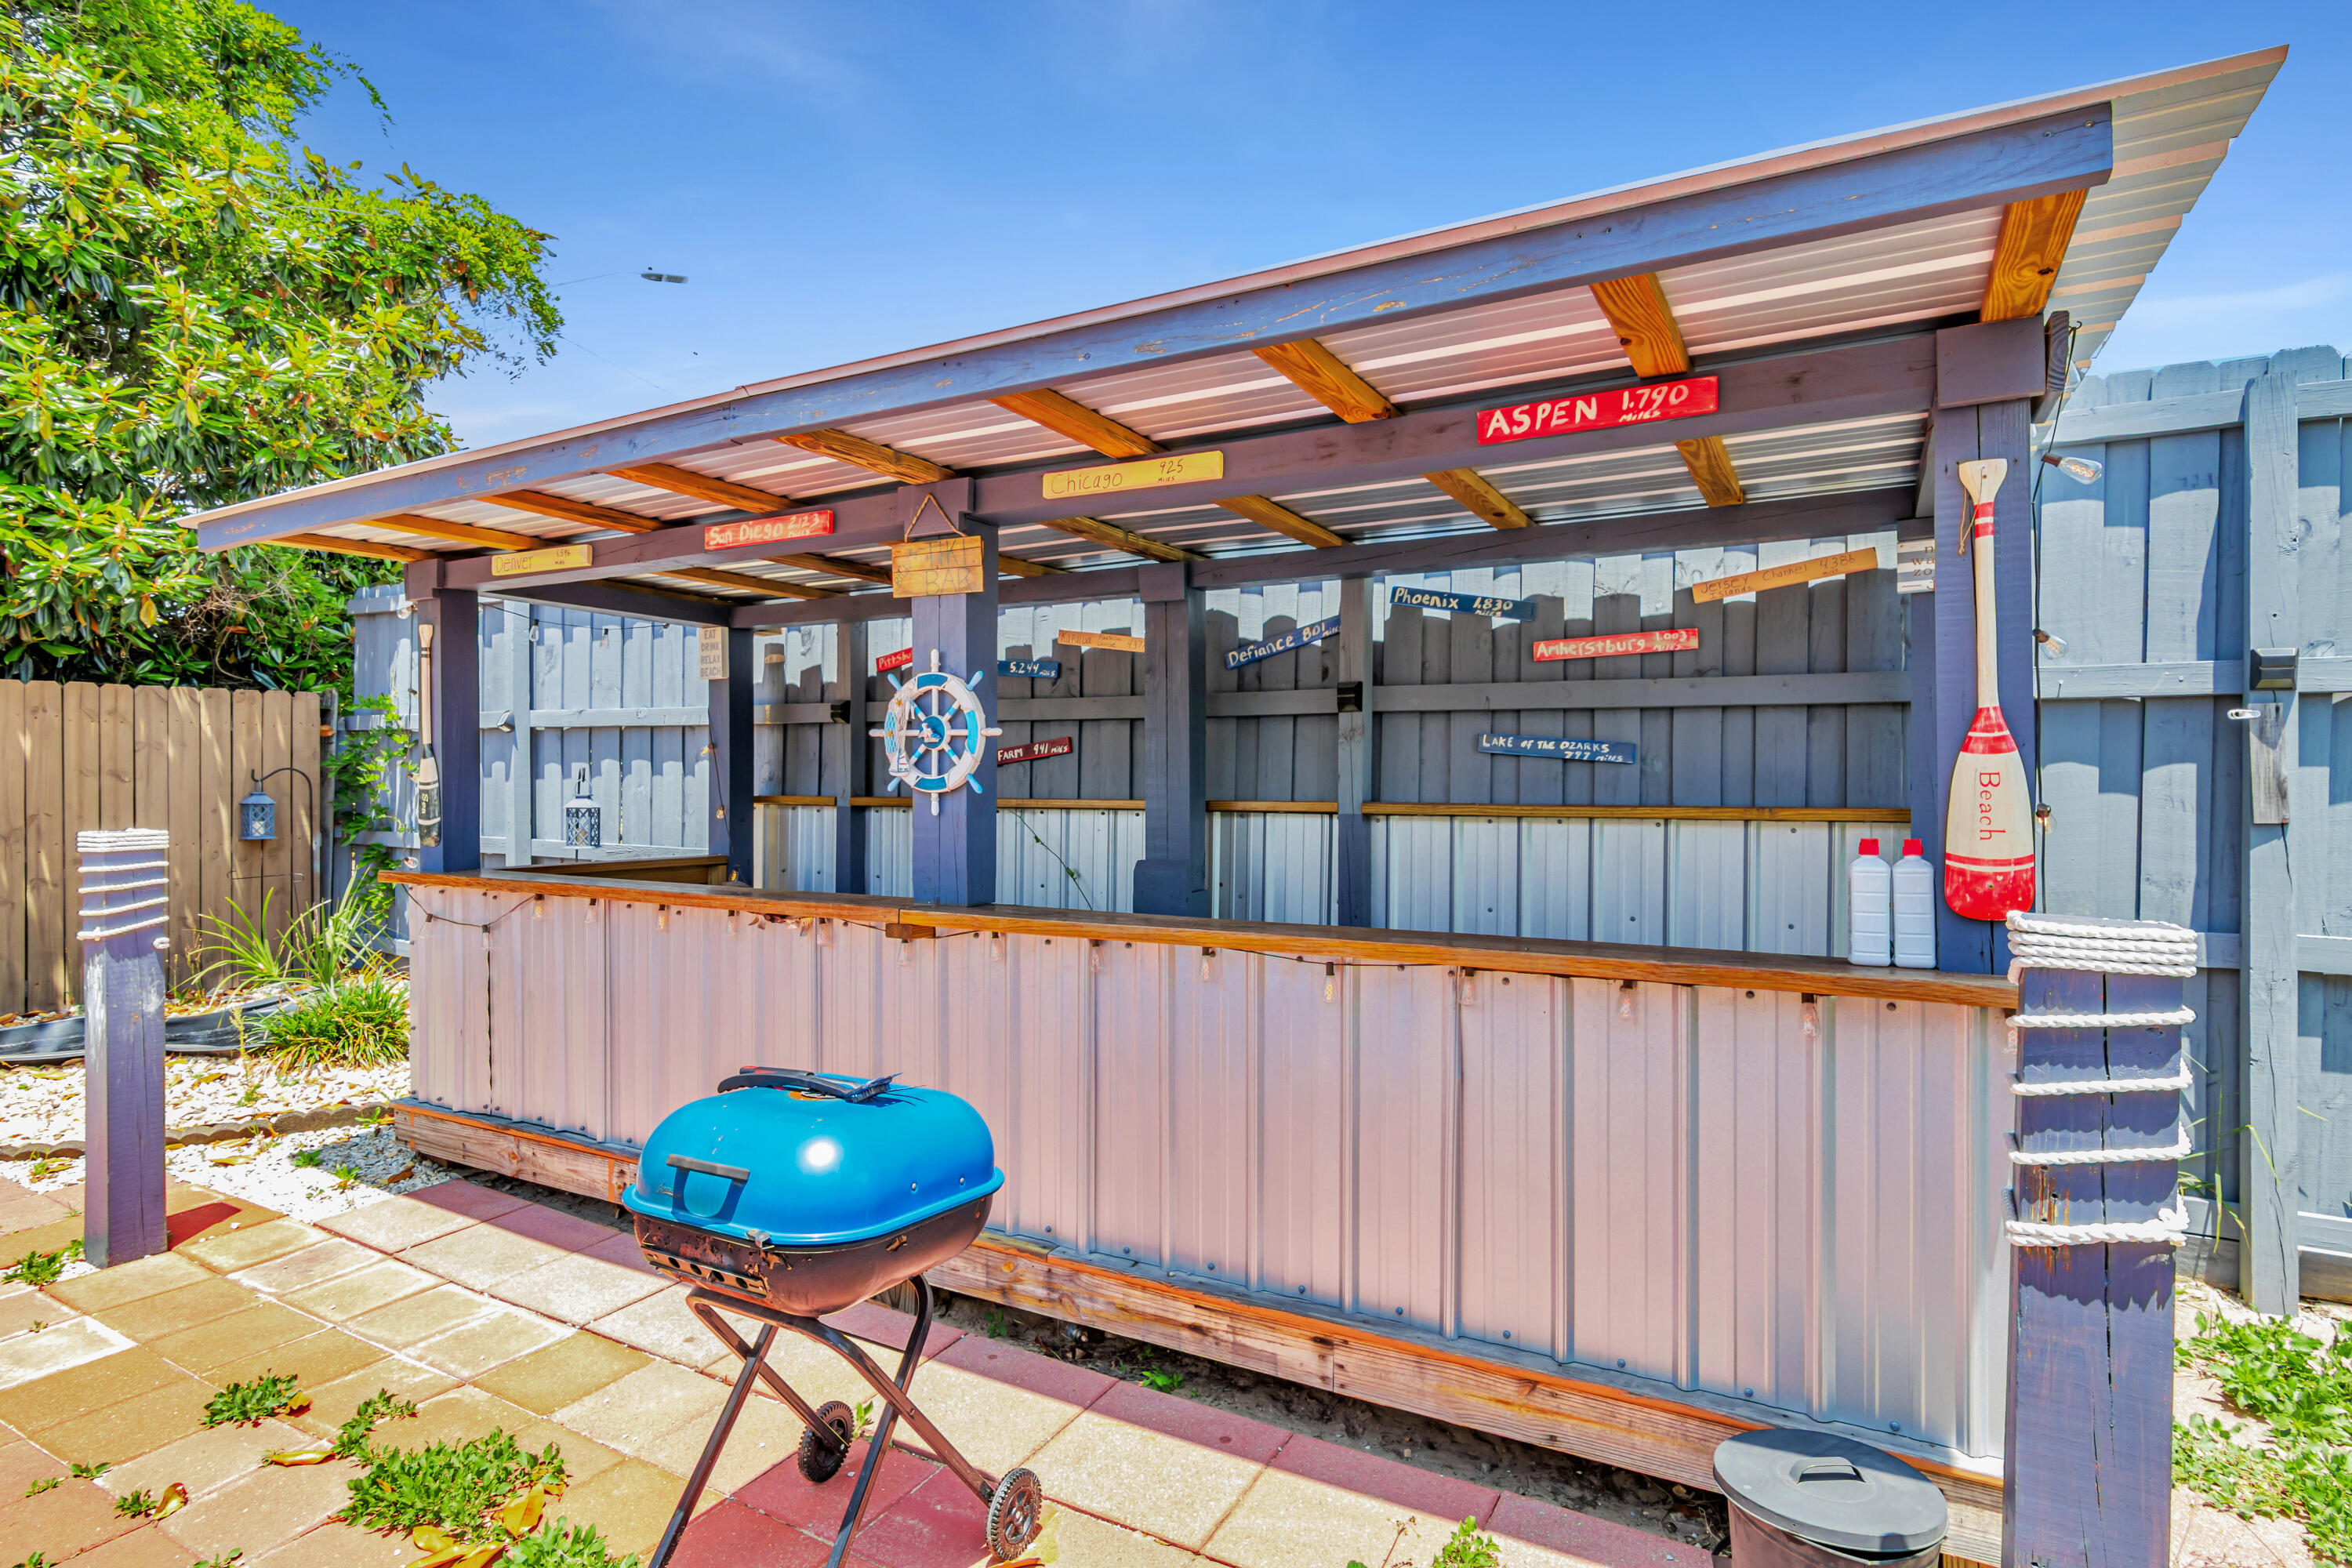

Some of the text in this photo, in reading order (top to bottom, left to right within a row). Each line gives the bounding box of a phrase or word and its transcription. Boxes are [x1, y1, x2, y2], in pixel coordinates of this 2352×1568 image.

[1486, 385, 1689, 438] ASPEN 1.790
[1051, 458, 1185, 495] Chicago 925
[709, 528, 732, 545] San
[739, 521, 783, 541] Diego
[922, 539, 967, 568] TIKI
[495, 556, 533, 573] Denver
[926, 567, 973, 596] BAR
[1700, 575, 1749, 594] Jersey
[1762, 564, 1808, 581] Channel
[1394, 587, 1459, 609] Phoenix
[704, 629, 716, 640] EAT
[1228, 622, 1326, 666] Defiance 801
[701, 641, 720, 652] DRINK
[1536, 639, 1646, 659] Amherstburg
[701, 655, 720, 665] RELAX
[879, 652, 912, 670] Pittsbu
[700, 666, 721, 677] BEACH
[997, 748, 1023, 761] FARM
[1034, 742, 1049, 755] 941
[1483, 734, 1514, 747] LAKE
[1520, 739, 1534, 750] of
[1559, 741, 1610, 753] OZARKS
[1979, 771, 2006, 840] Beach
